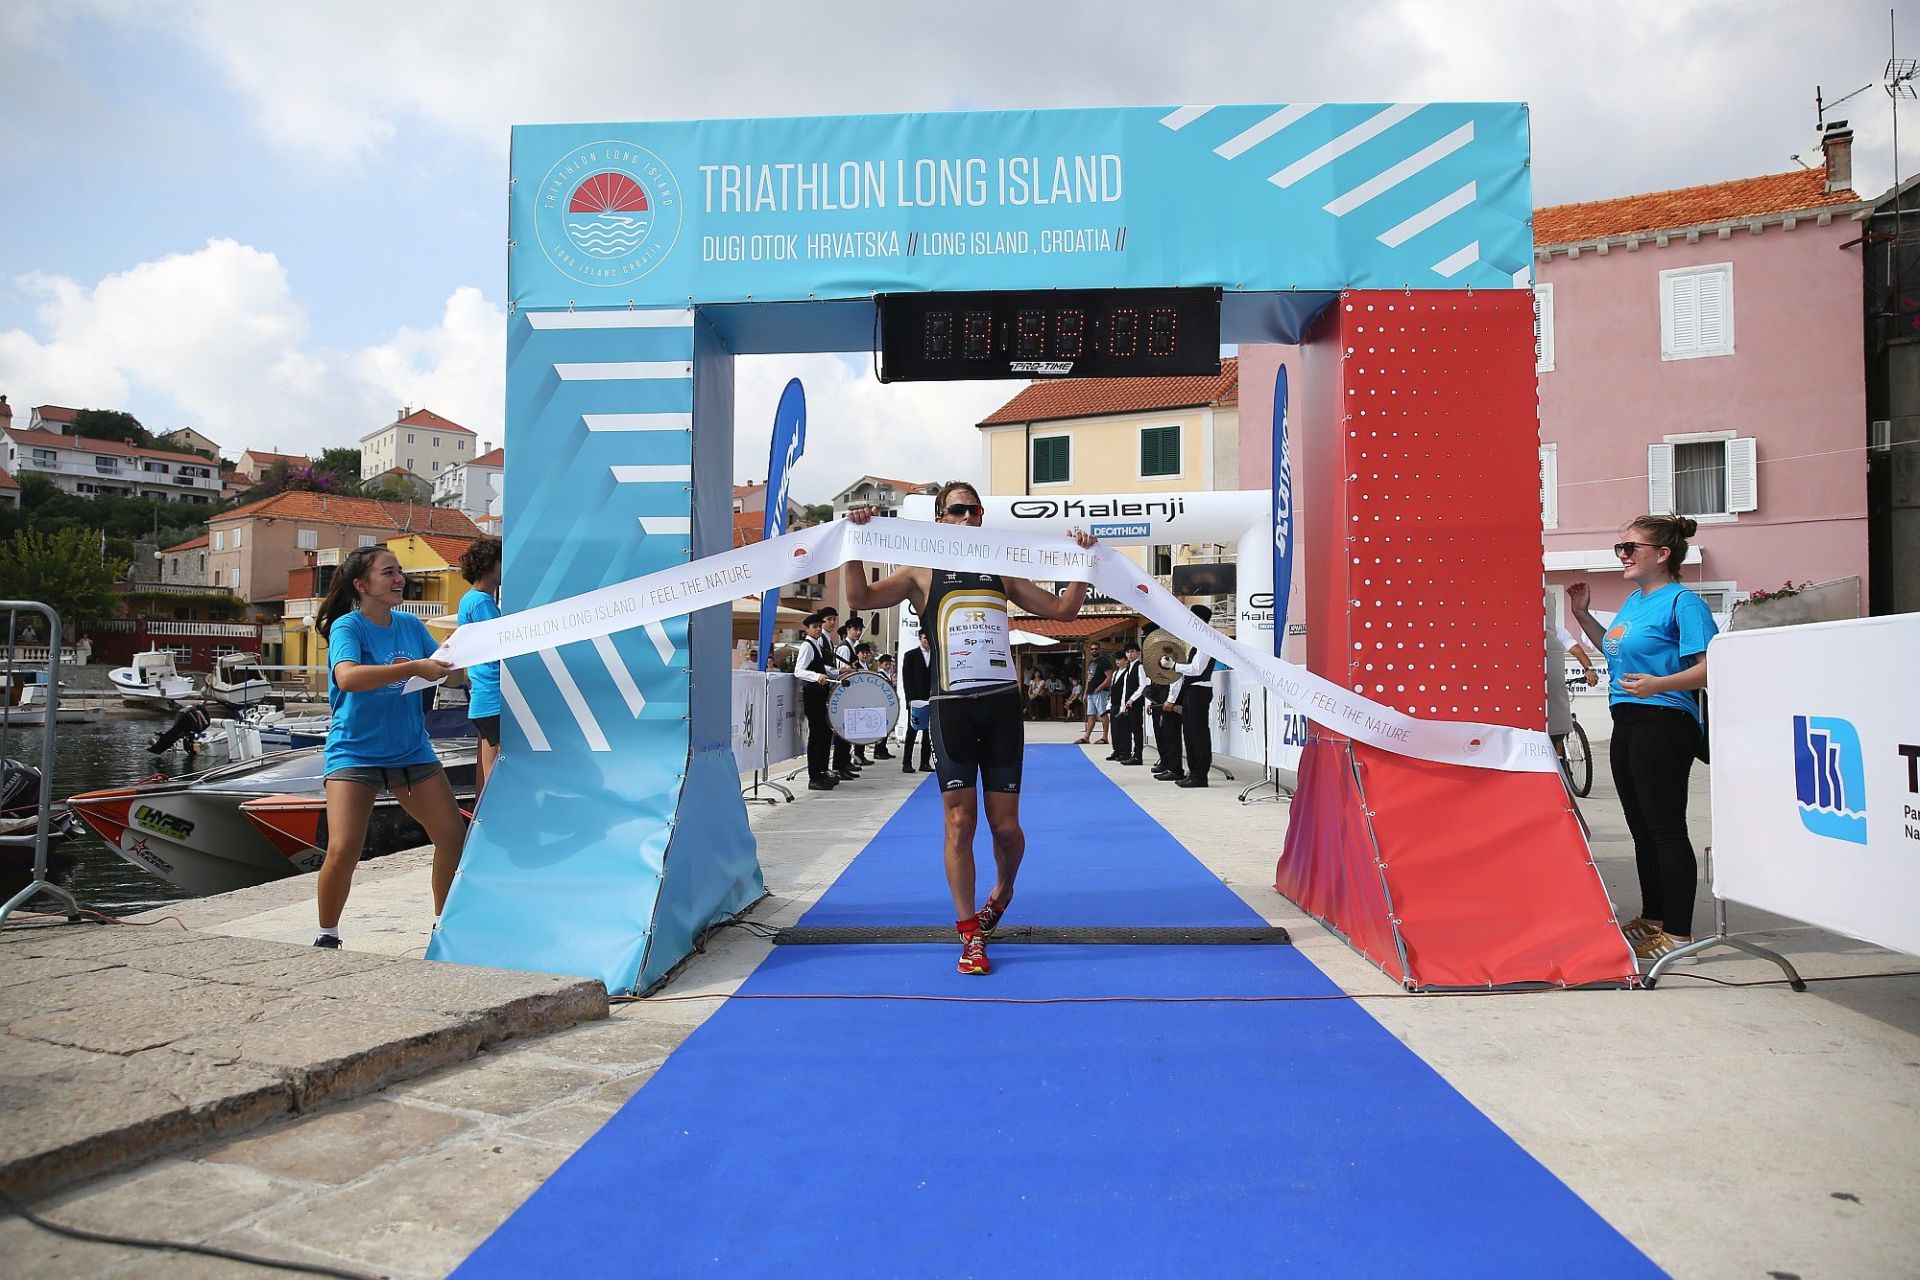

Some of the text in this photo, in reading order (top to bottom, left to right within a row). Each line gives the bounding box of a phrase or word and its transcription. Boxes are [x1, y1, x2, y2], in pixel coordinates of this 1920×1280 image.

[544, 150, 673, 209] TRIATHLON LONG ISLAND
[699, 153, 1123, 213] TRIATHLON LONG ISLAND
[703, 235, 745, 261] DUGI
[751, 234, 797, 260] OTOK
[807, 231, 900, 259] HRVATSKA
[923, 232, 965, 256] LONG
[1041, 229, 1111, 252] CROATIA
[1064, 497, 1184, 522] Kalenji
[847, 530, 910, 550] TRIATHLON
[914, 537, 945, 555] LONG
[948, 540, 990, 559] ISLAND
[1006, 547, 1033, 564] FEEL
[1039, 549, 1060, 566] THE
[1093, 526, 1147, 536] DECATHLON
[497, 620, 559, 644] TRIATHLON
[562, 609, 592, 632] LONG
[595, 597, 636, 620] ISLAND
[650, 584, 679, 605] FEEL
[681, 574, 704, 597] THE
[706, 563, 752, 589] NATURE
[949, 624, 1002, 632] RESIDENCE
[831, 676, 864, 714] GRADKA
[1262, 670, 1300, 699] ISLAND
[1310, 691, 1338, 715] FEEL
[1341, 704, 1364, 725] THE
[1365, 715, 1412, 743] NATURE
[141, 805, 195, 836] HYPER
